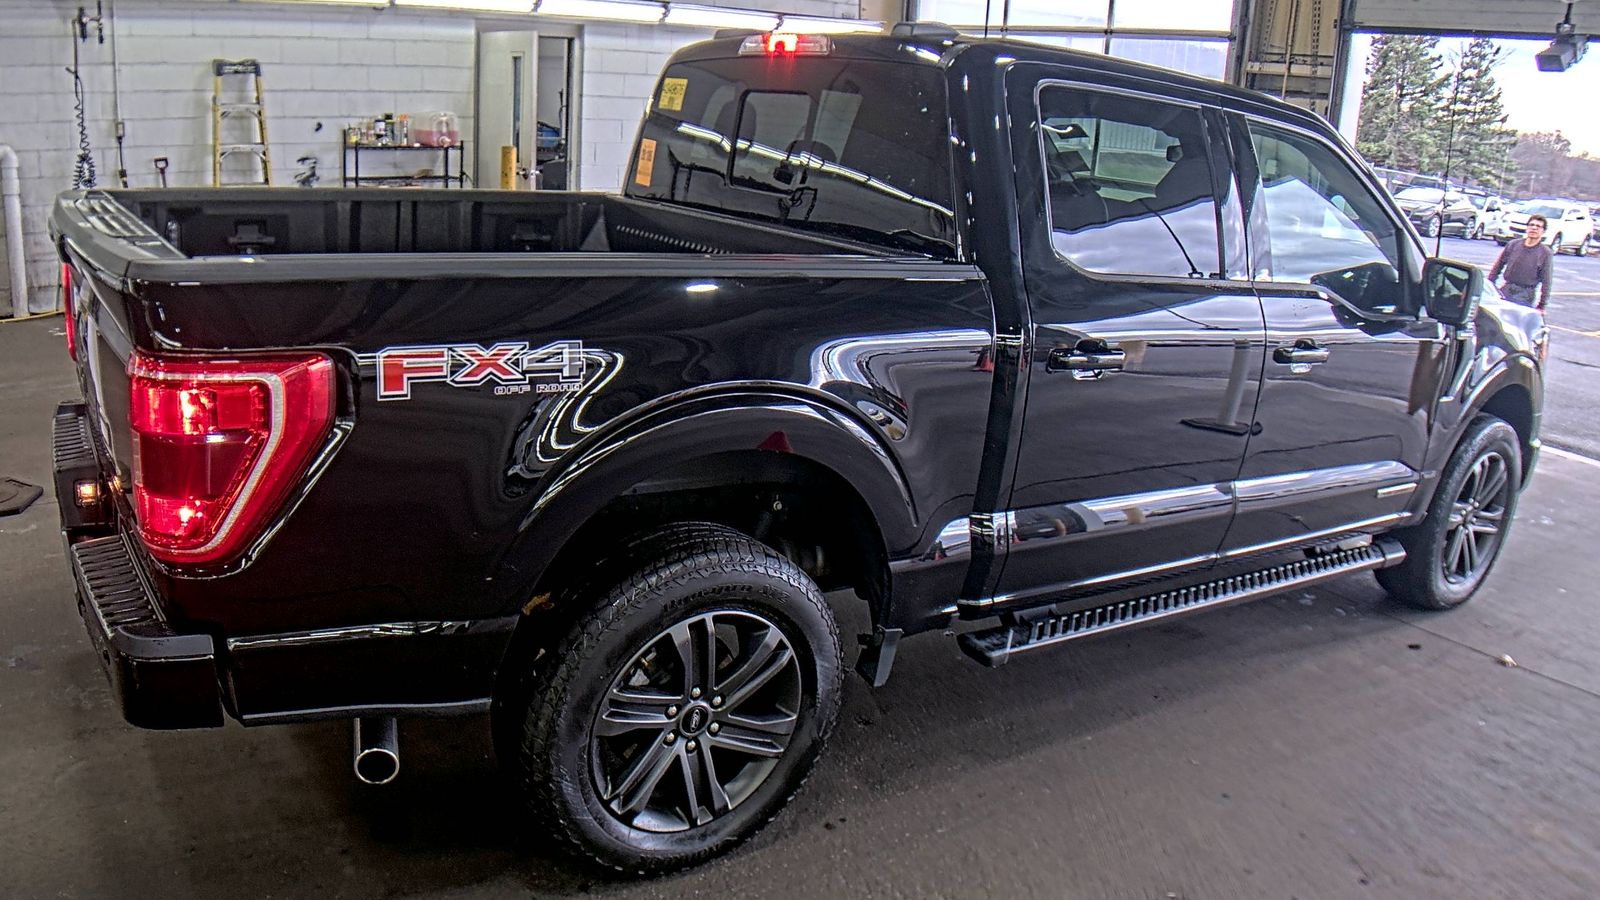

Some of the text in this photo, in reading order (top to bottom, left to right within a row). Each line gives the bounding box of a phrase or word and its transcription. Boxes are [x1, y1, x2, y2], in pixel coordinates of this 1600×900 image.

[377, 340, 585, 401] FX4
[494, 383, 582, 395] OFF ROAD
